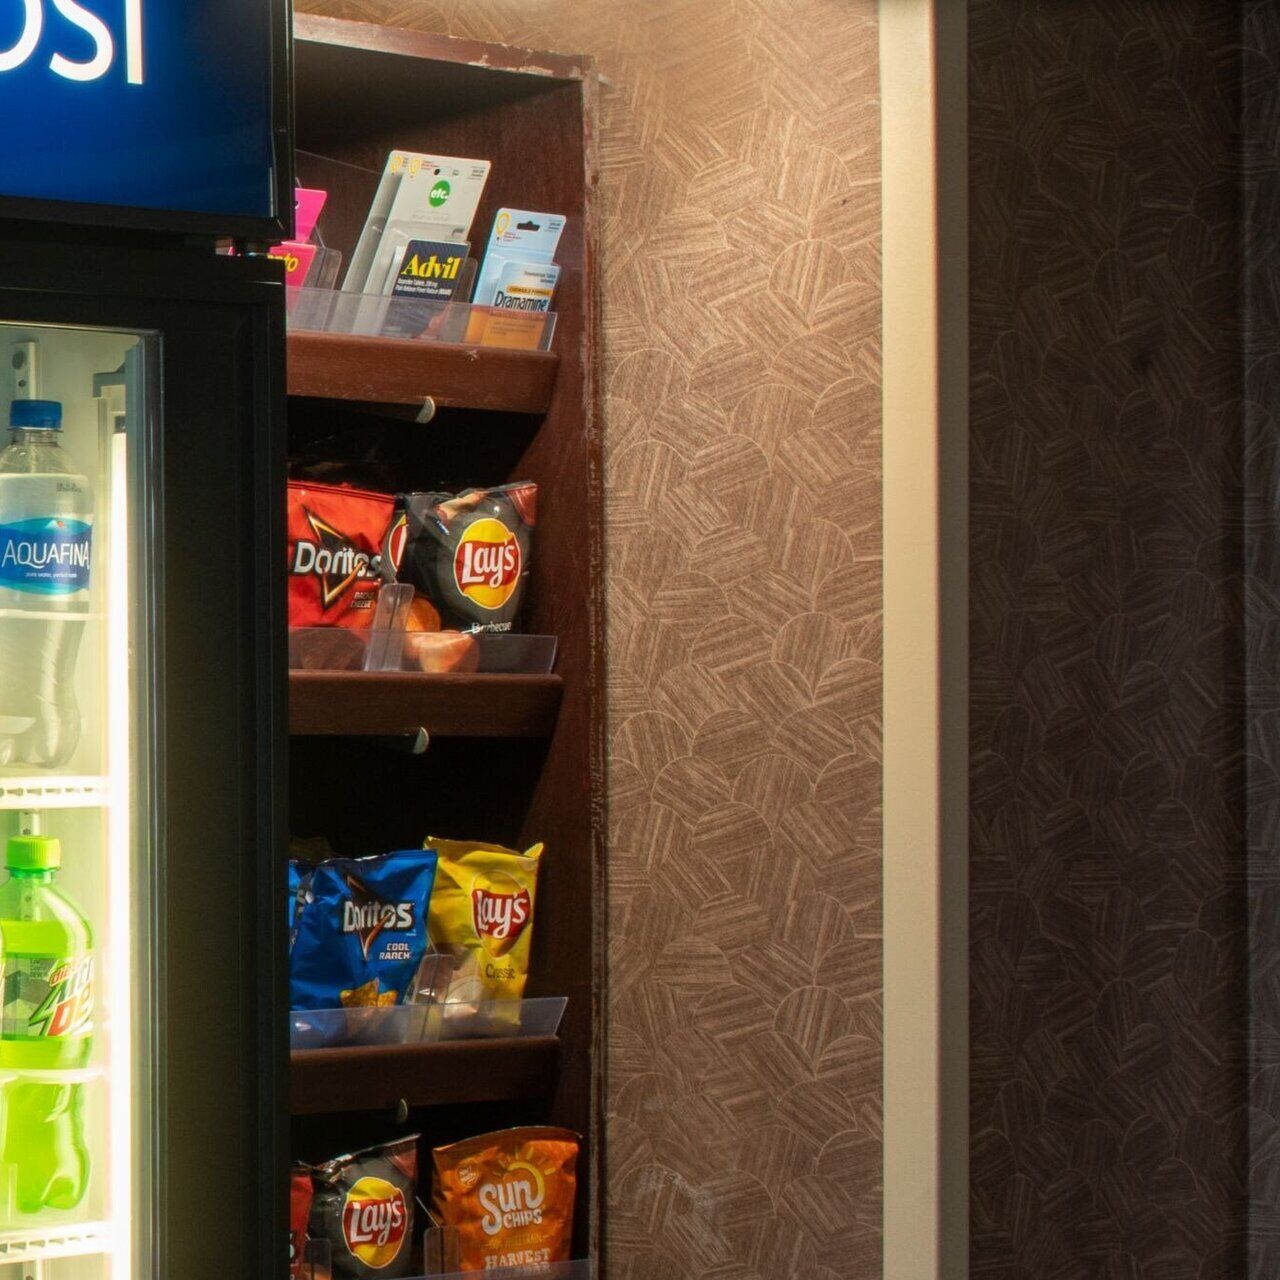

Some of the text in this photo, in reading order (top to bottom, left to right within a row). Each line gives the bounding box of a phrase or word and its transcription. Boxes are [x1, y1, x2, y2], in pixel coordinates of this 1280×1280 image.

[429, 188, 449, 201] etc.
[400, 253, 461, 280] Advil
[494, 290, 547, 312] Dramamine
[1, 539, 90, 571] AQUAFINA
[293, 541, 382, 580] Doritos
[461, 537, 515, 588] Lay's
[342, 900, 415, 932] Doritos
[477, 889, 528, 940] Lay's
[386, 942, 411, 952] COOL
[350, 1194, 403, 1246] Lay's
[479, 1179, 545, 1236] Sun
[503, 1208, 543, 1229] CHIPS
